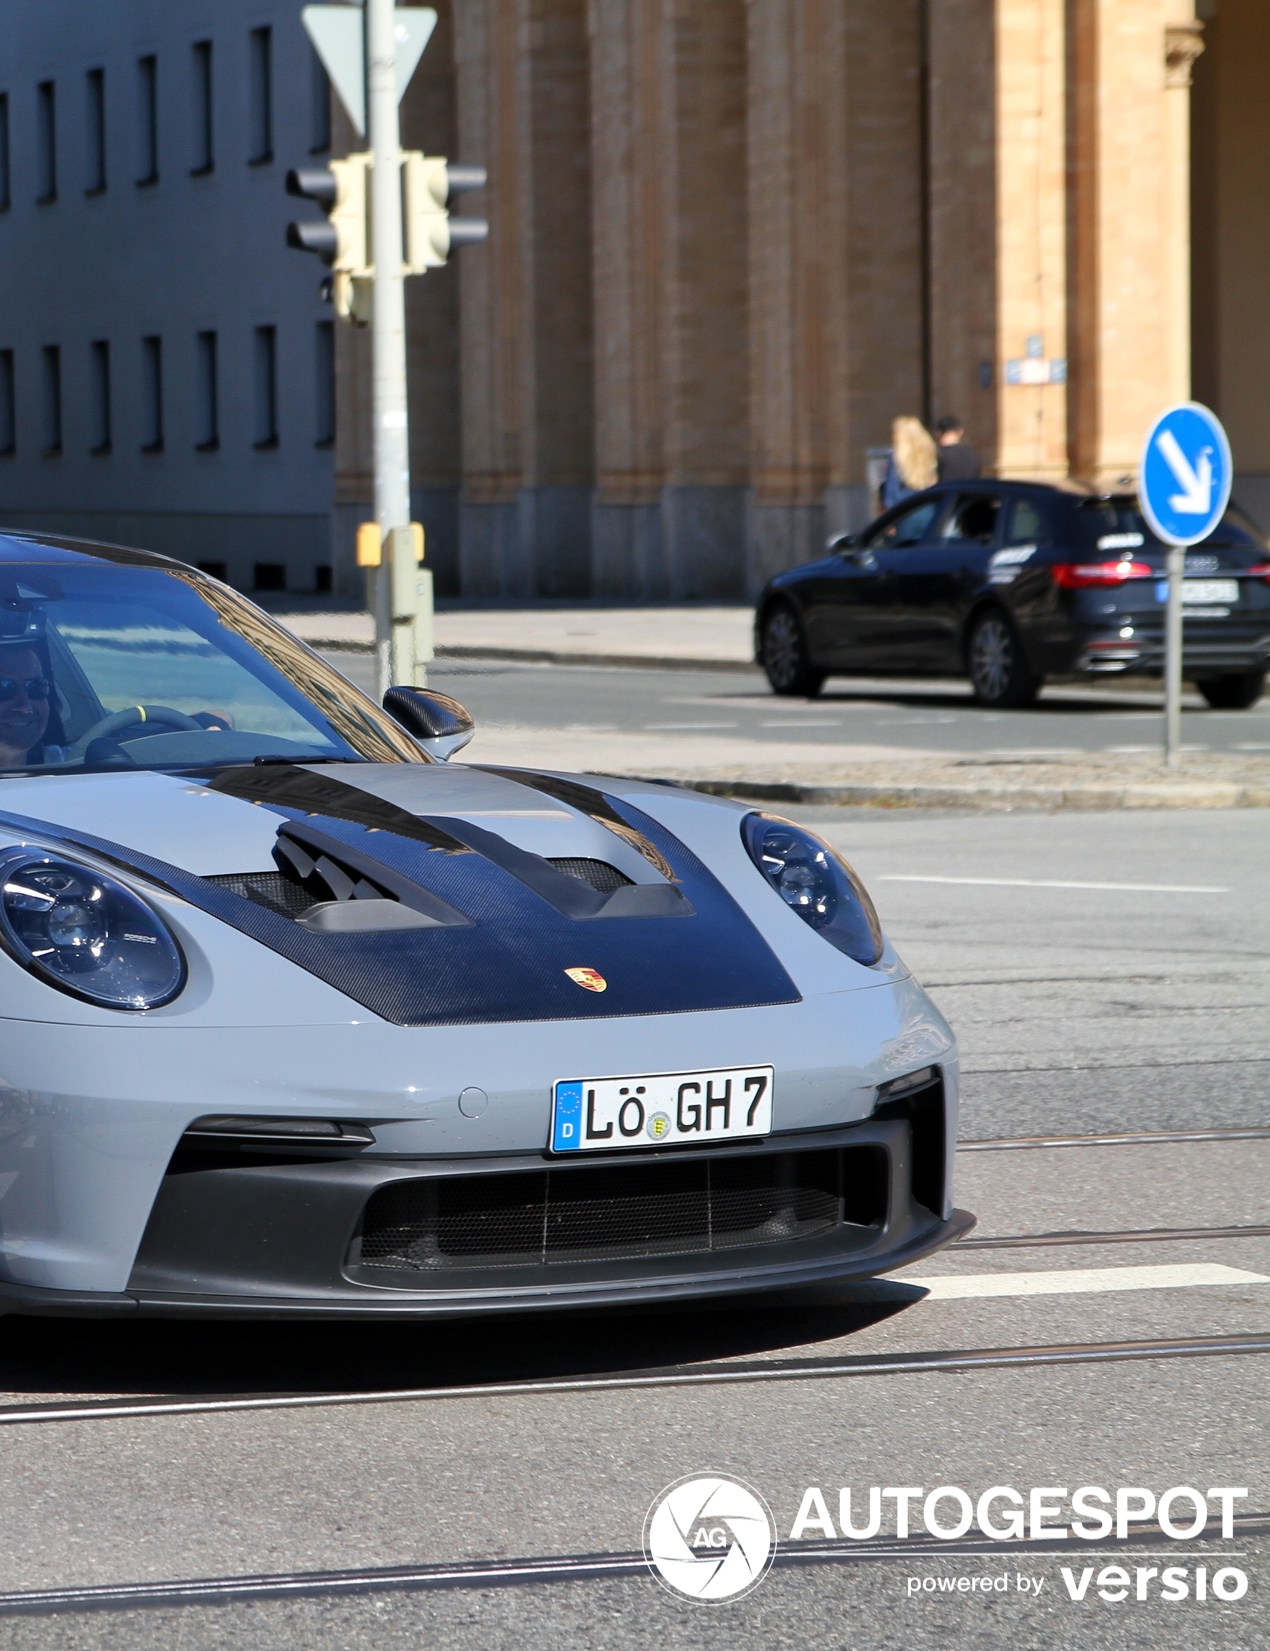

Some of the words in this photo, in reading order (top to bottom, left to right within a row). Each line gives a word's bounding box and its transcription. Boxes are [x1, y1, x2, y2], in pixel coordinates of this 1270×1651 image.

[586, 1086, 646, 1140] LÖ
[676, 1079, 732, 1133] GH
[744, 1075, 768, 1127] 7
[562, 1123, 574, 1138] D
